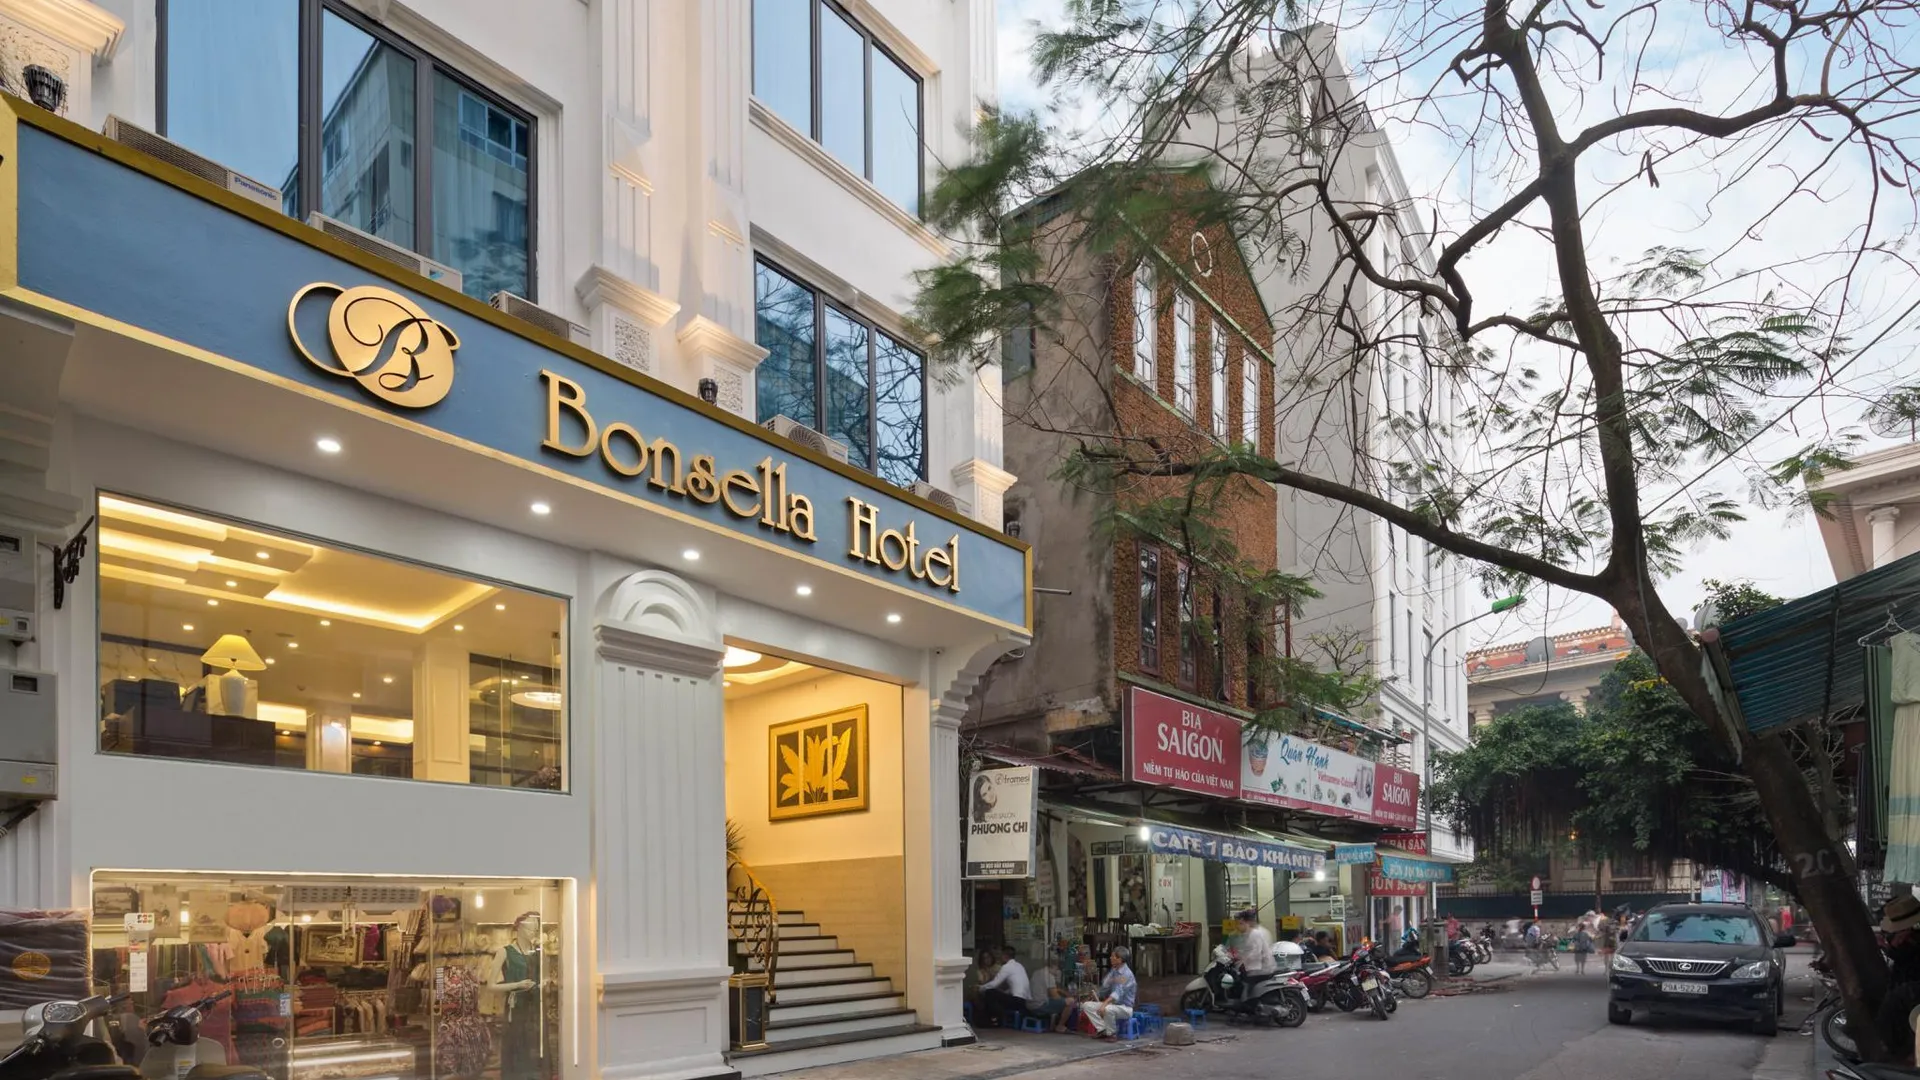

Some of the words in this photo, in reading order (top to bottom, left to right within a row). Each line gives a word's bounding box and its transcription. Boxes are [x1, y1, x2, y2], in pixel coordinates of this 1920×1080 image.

[539, 368, 818, 543] Bonsella
[846, 496, 960, 592] Hotel
[1182, 709, 1202, 731] BIA
[1157, 722, 1224, 764] SAIGON
[1220, 779, 1234, 790] NAM
[1393, 772, 1403, 785] BIA
[1383, 782, 1411, 807] SAIGON
[1012, 821, 1028, 833] CHI
[1206, 840, 1217, 856] 1
